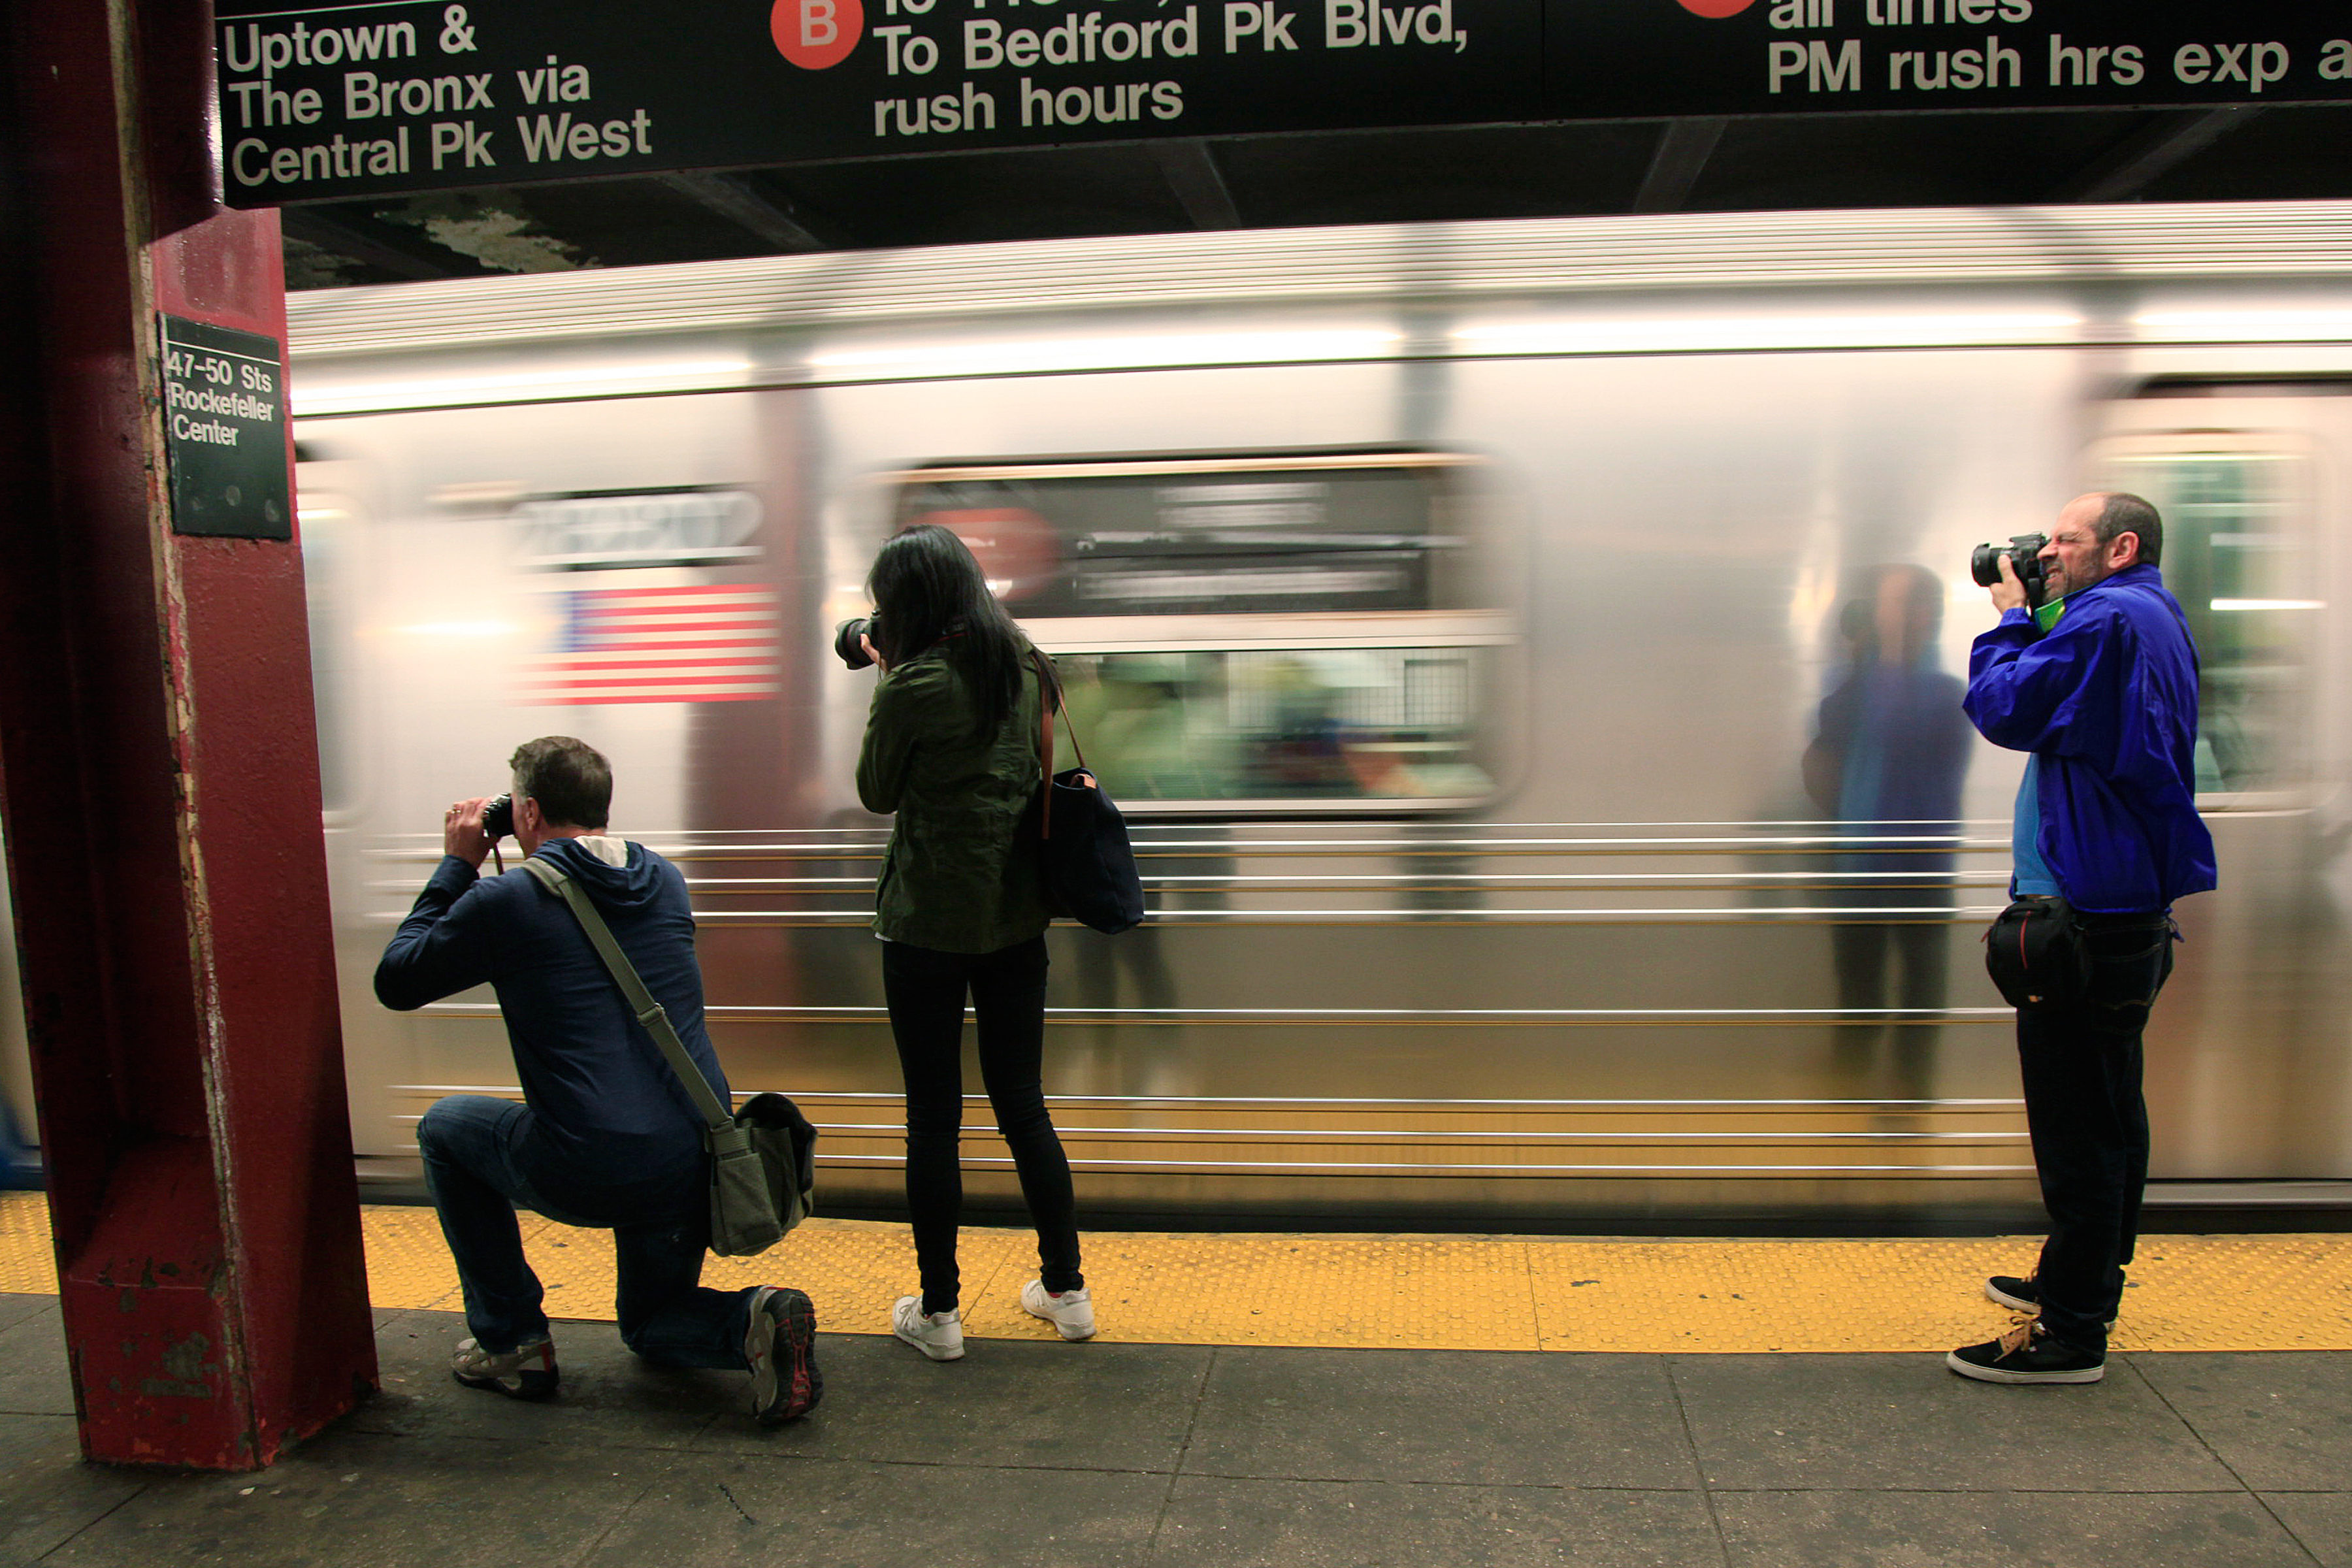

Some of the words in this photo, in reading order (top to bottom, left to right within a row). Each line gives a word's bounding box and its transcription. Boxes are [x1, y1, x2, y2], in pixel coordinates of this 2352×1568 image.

[225, 22, 417, 80] Uptown
[439, 4, 478, 54] &
[800, 0, 838, 47] B
[873, 24, 939, 76] To
[964, 5, 1198, 70] Bedford
[1224, 0, 1299, 54] Pk
[1324, 0, 1467, 54] Blvd,
[229, 80, 323, 128] The
[344, 72, 495, 120] Bronx
[516, 55, 591, 105] via
[1769, 39, 1861, 93] PM
[1889, 35, 2021, 90] rush
[2050, 34, 2144, 86] hrs
[2174, 41, 2289, 93] exp
[874, 81, 996, 137] rush
[1021, 77, 1184, 127] hours
[231, 126, 410, 186] Central
[431, 121, 496, 171] Pk
[516, 108, 652, 163] West
[169, 351, 233, 385] 47-50
[240, 363, 273, 393] Sts
[171, 382, 274, 421] Rockefeller
[173, 414, 239, 446] Center
